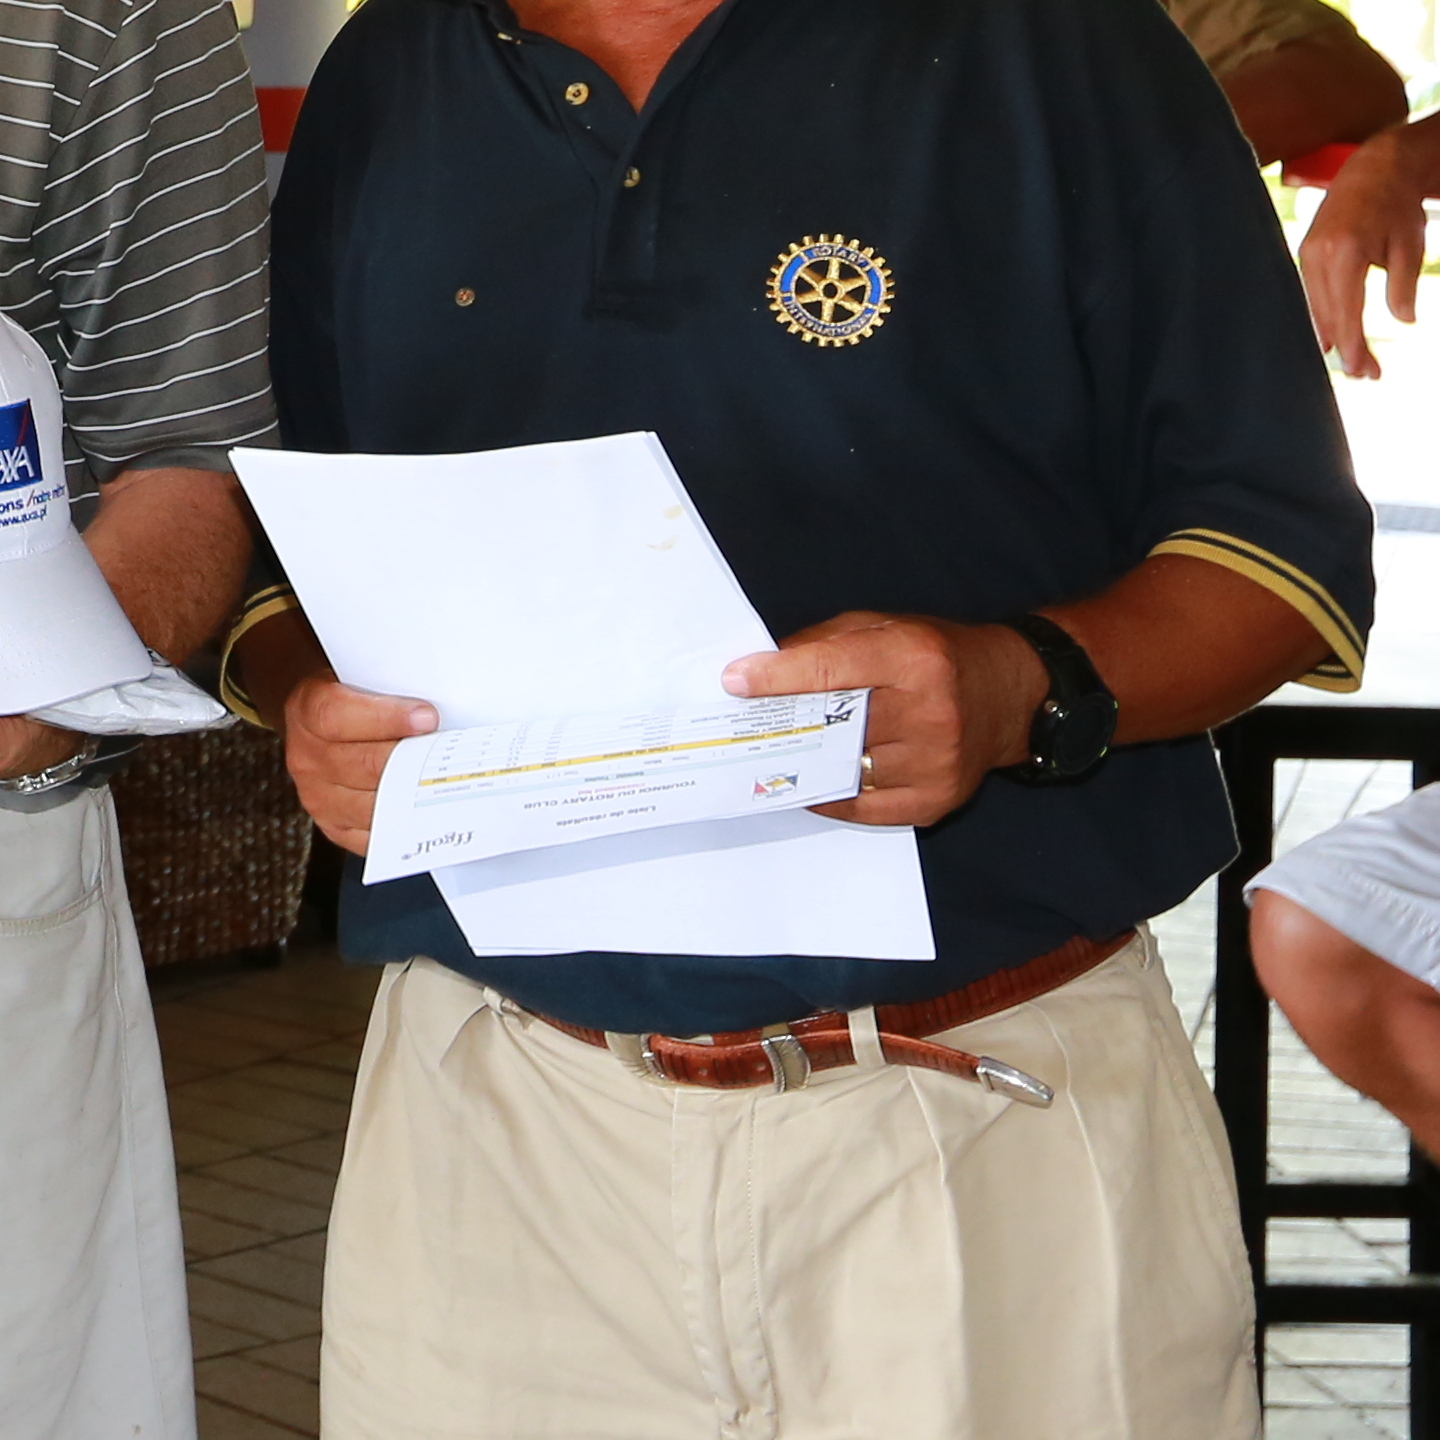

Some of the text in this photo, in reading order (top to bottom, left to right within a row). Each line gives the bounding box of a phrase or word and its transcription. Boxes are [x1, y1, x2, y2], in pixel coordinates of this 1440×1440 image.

[523, 779, 697, 810] TOURNOI DU ROTARY CLUB
[628, 804, 657, 815] Liste
